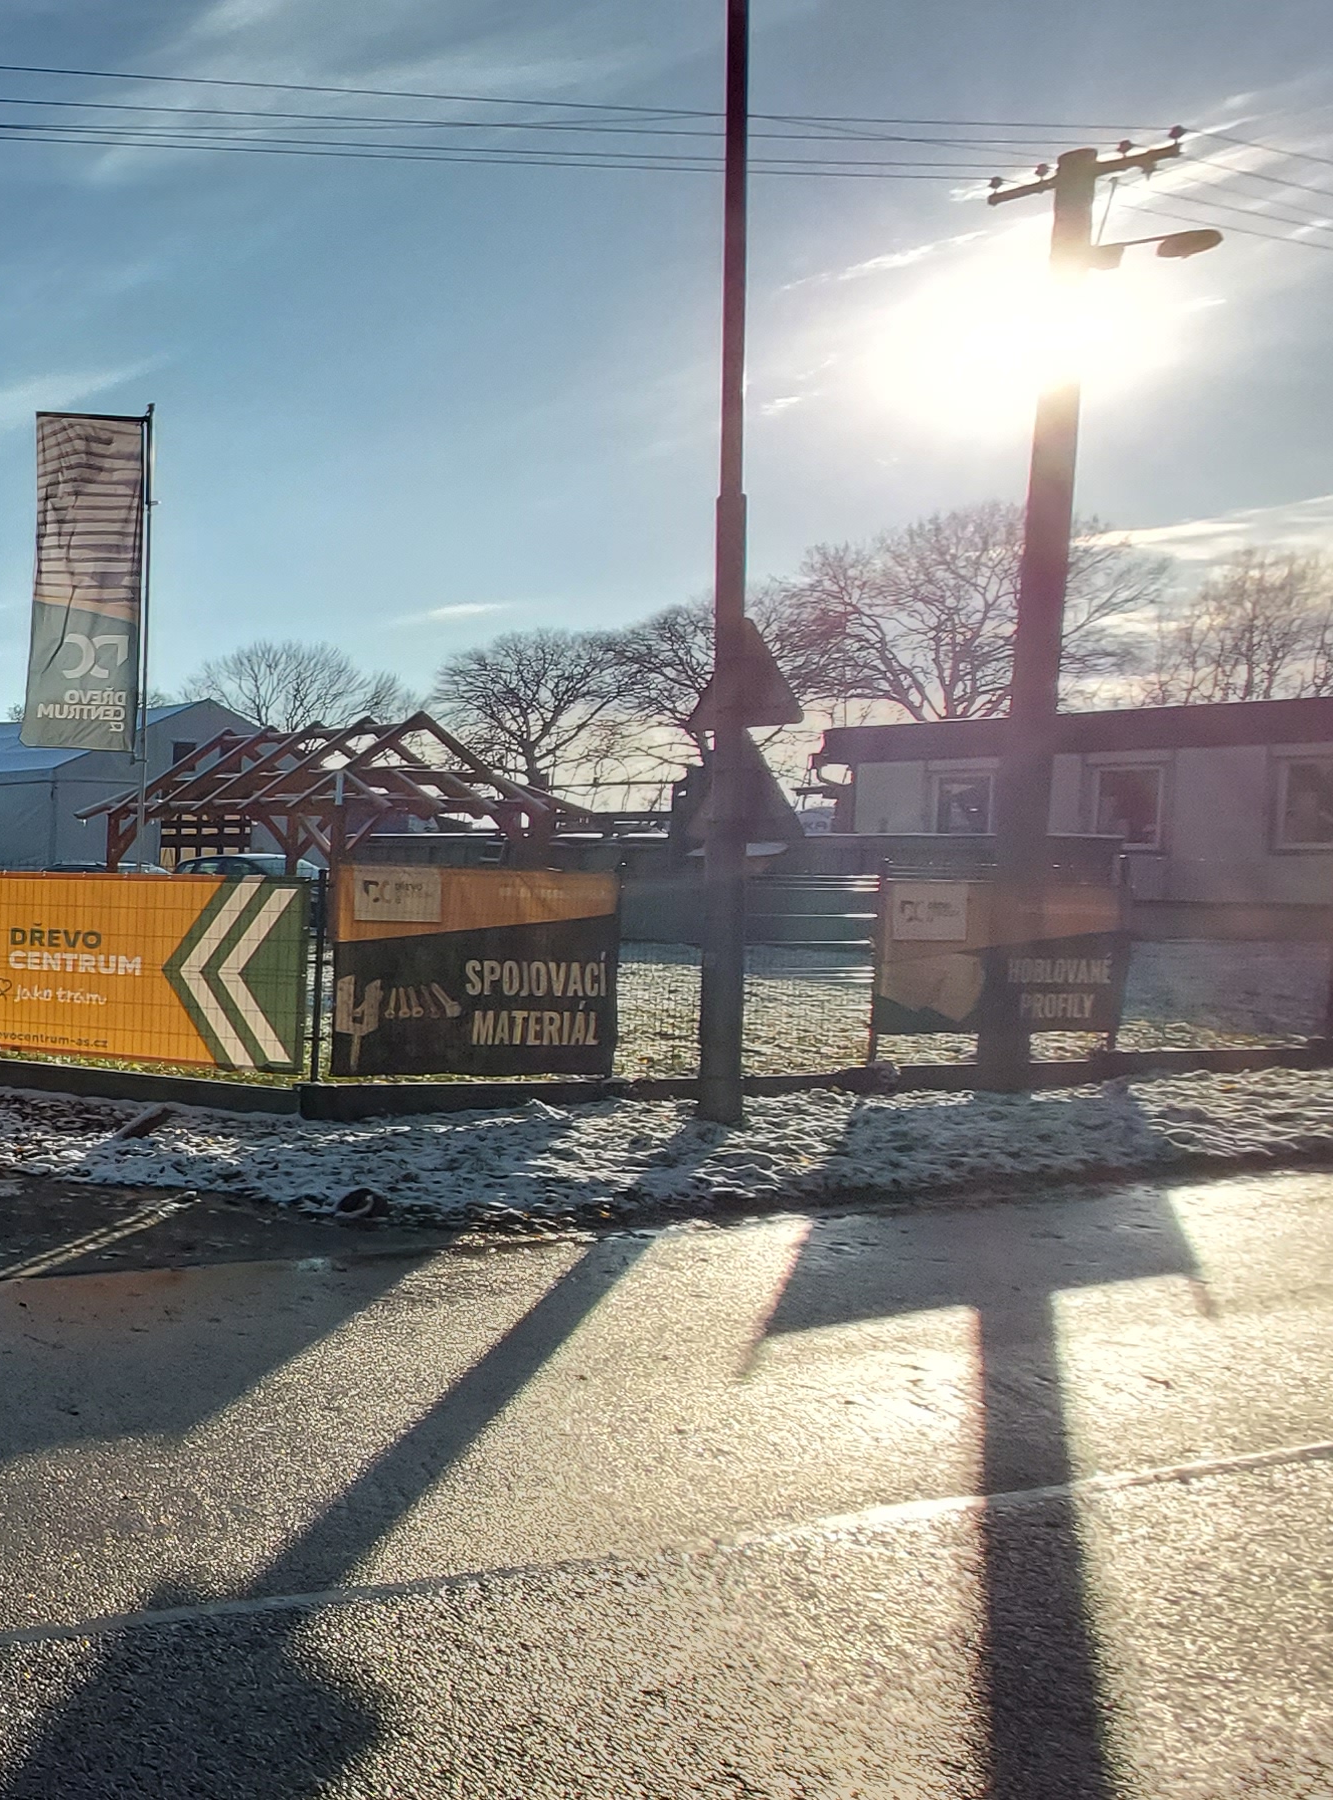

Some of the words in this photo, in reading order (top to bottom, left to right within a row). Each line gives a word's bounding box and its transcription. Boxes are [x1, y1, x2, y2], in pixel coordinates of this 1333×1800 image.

[10, 923, 102, 949] DŘEVO
[8, 950, 143, 976] CENTRUM
[465, 951, 607, 997] SPOJOVACÍ
[1007, 953, 1113, 984] HOBLOVANÉ
[14, 984, 53, 1003] jako
[56, 985, 107, 1005] trám
[1021, 992, 1096, 1019] PROFILY
[471, 1000, 600, 1046] MATERIÁL
